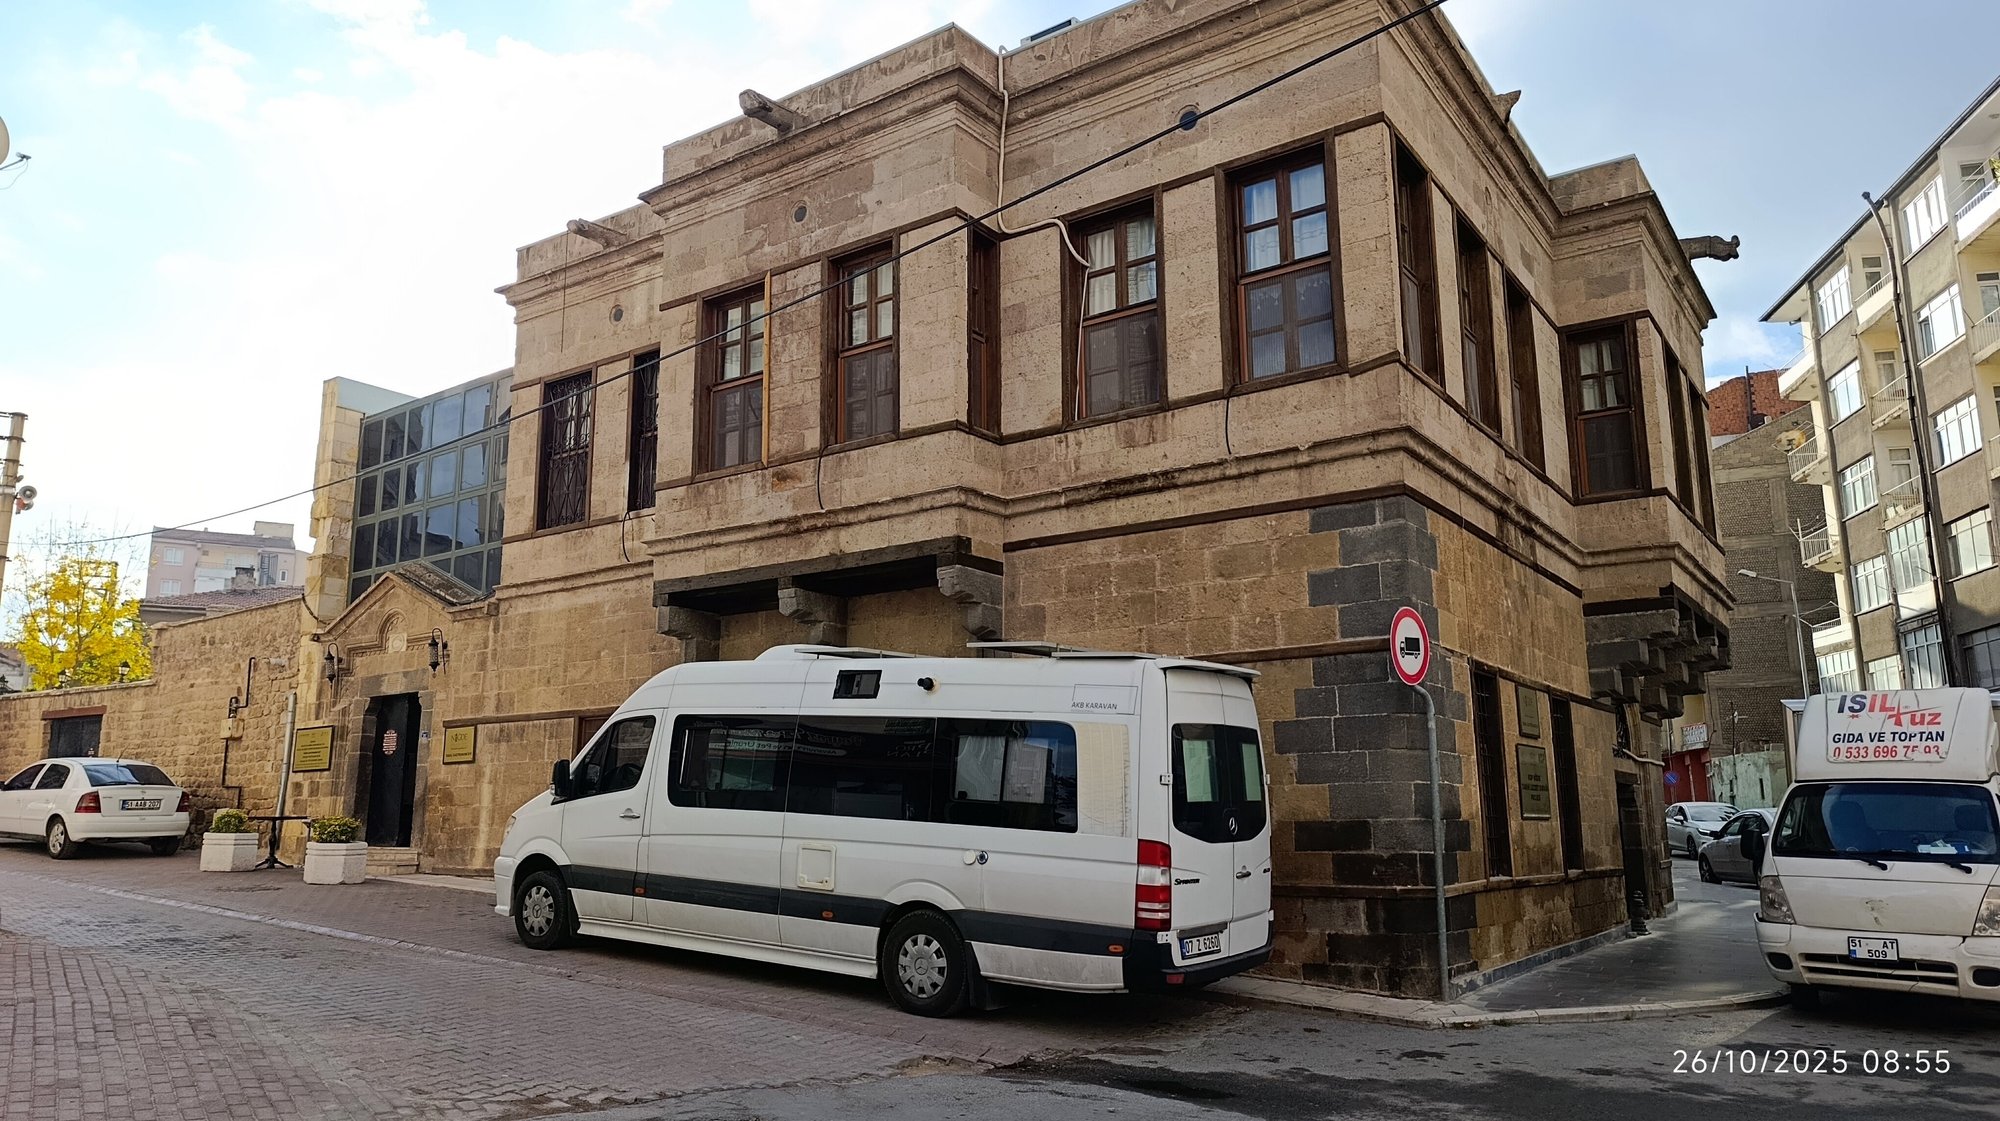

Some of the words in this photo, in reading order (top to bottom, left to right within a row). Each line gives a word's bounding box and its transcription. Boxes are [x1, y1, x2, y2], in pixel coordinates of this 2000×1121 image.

[1071, 701, 1084, 709] AKB
[1085, 702, 1118, 710] KARAVAN
[1832, 732, 1864, 744] GIDA
[1868, 731, 1886, 743] VE
[1833, 746, 1841, 759] 0
[1845, 745, 1869, 759] 533
[1873, 745, 1898, 758] 696
[1184, 940, 1194, 954] 07
[1196, 938, 1202, 952] Z
[1203, 935, 1219, 951] 6260
[1850, 938, 1862, 948] 51
[1882, 940, 1896, 950] AT
[1867, 949, 1888, 959] 509
